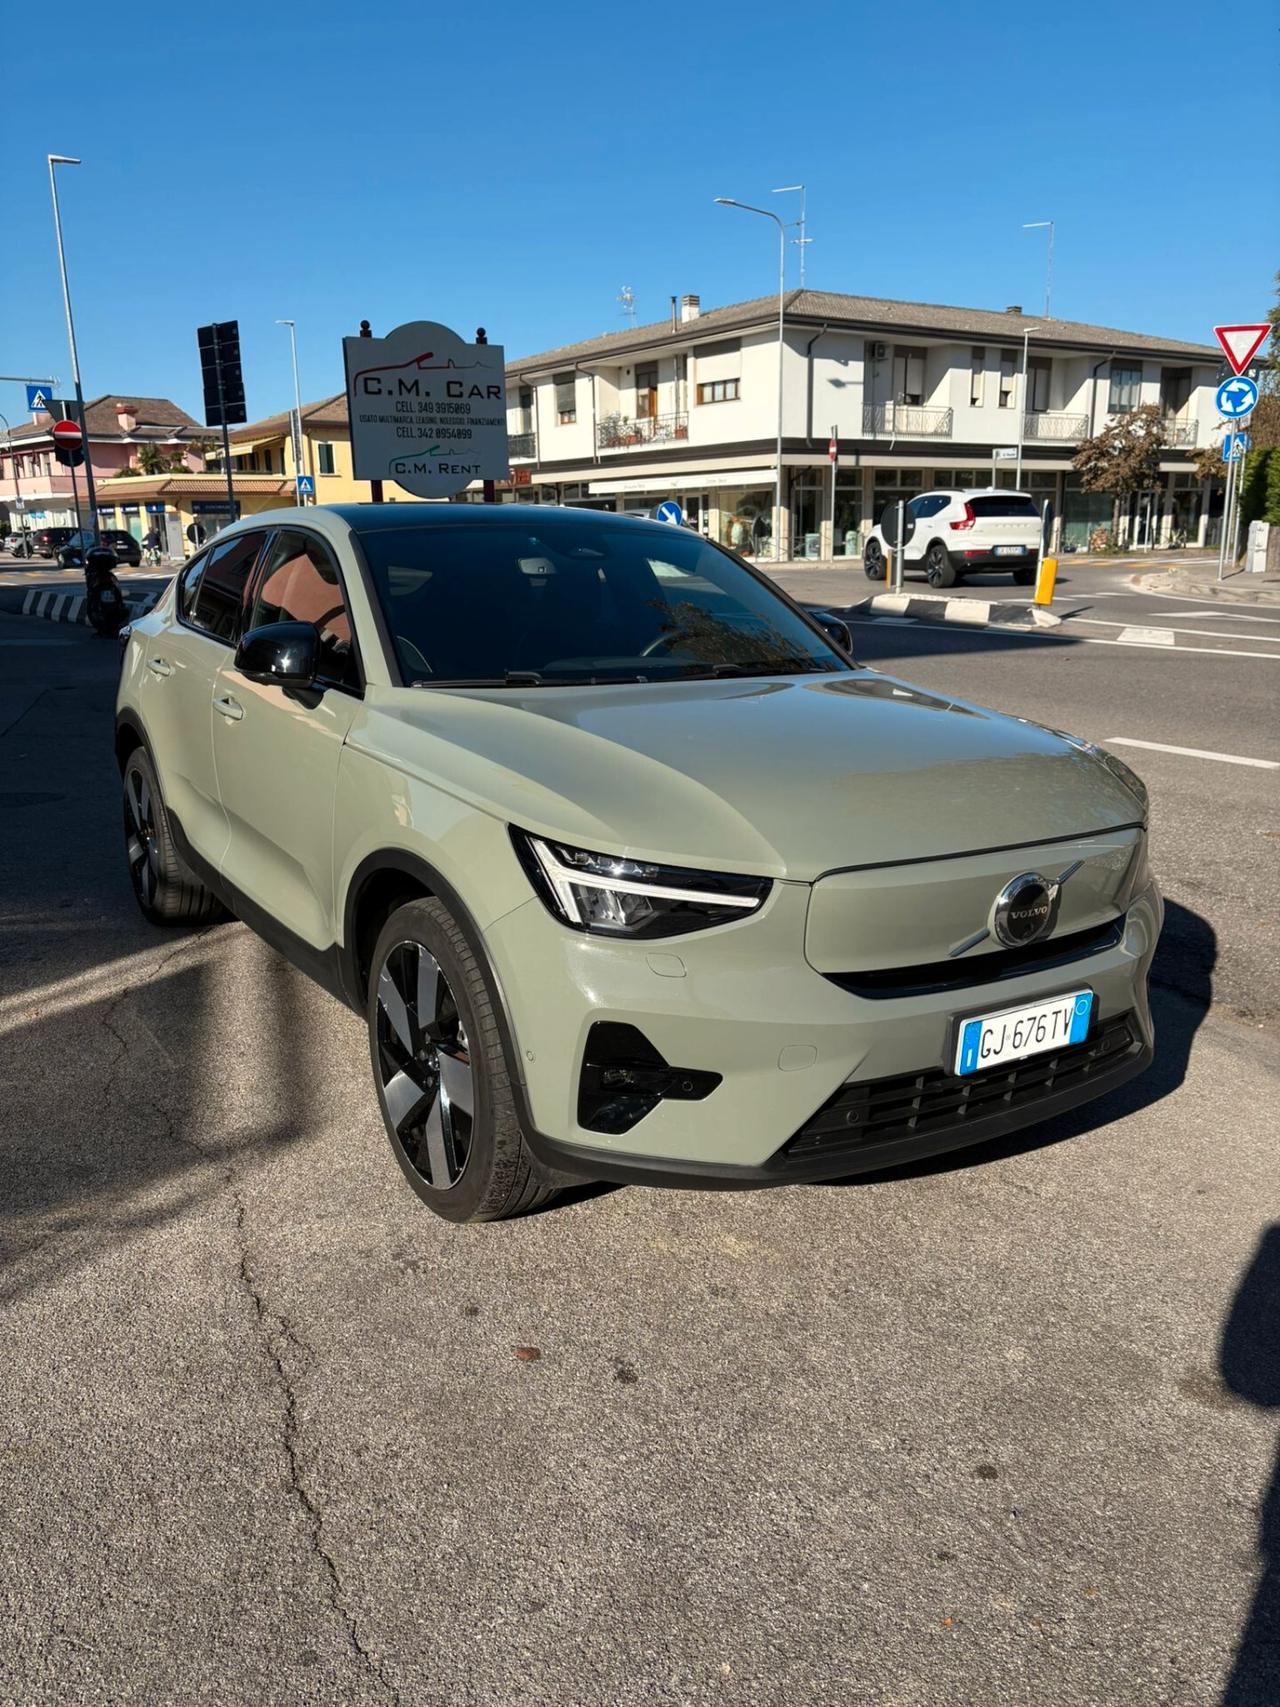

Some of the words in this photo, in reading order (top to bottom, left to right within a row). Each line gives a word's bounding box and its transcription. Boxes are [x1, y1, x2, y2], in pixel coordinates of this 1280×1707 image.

[363, 377, 431, 397] C.M.
[446, 380, 502, 400] CAR
[417, 402, 434, 414] 349
[417, 427, 433, 439] 342
[394, 462, 432, 474] C.M.
[438, 464, 481, 475] RENT
[1011, 906, 1048, 919] VOLVO
